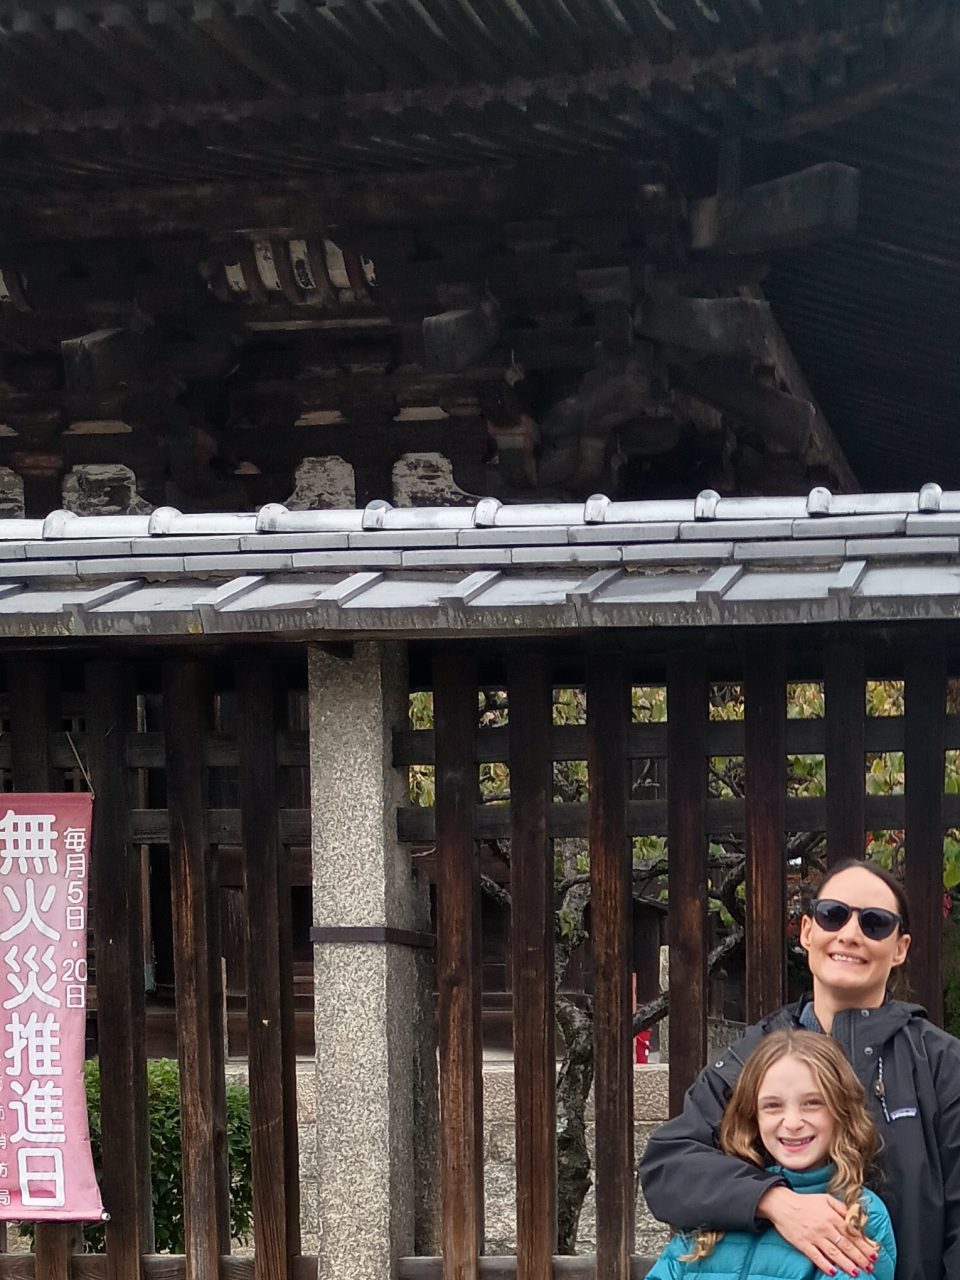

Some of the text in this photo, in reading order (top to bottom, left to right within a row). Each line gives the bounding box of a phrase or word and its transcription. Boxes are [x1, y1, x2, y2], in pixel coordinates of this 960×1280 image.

[0, 809, 66, 1208] 無火災推進日
[61, 827, 89, 1009] 毎月5日・20日
